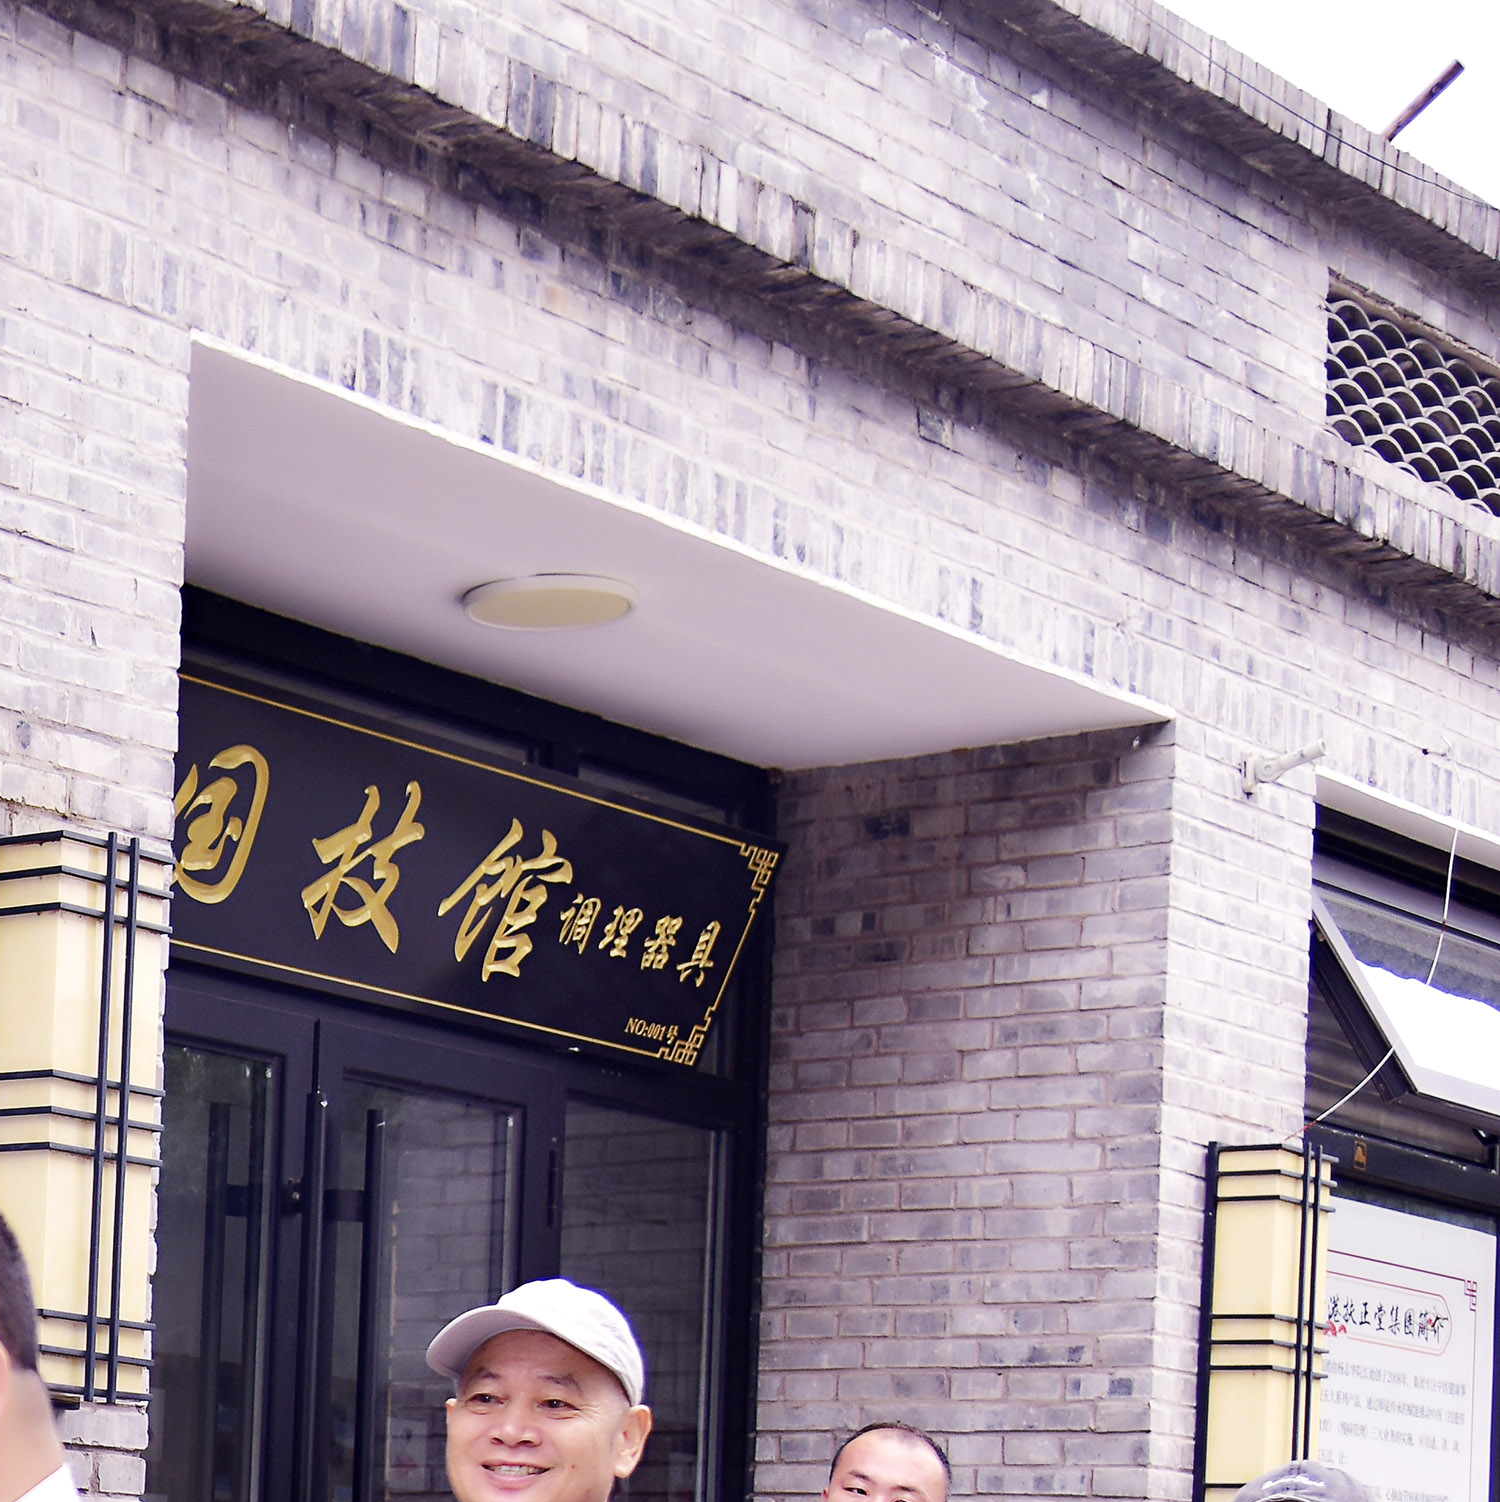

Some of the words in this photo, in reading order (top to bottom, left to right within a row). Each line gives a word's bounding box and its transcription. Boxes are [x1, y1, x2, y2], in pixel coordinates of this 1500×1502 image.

[170, 744, 573, 982] 国技馆
[558, 892, 722, 988] 调理器具
